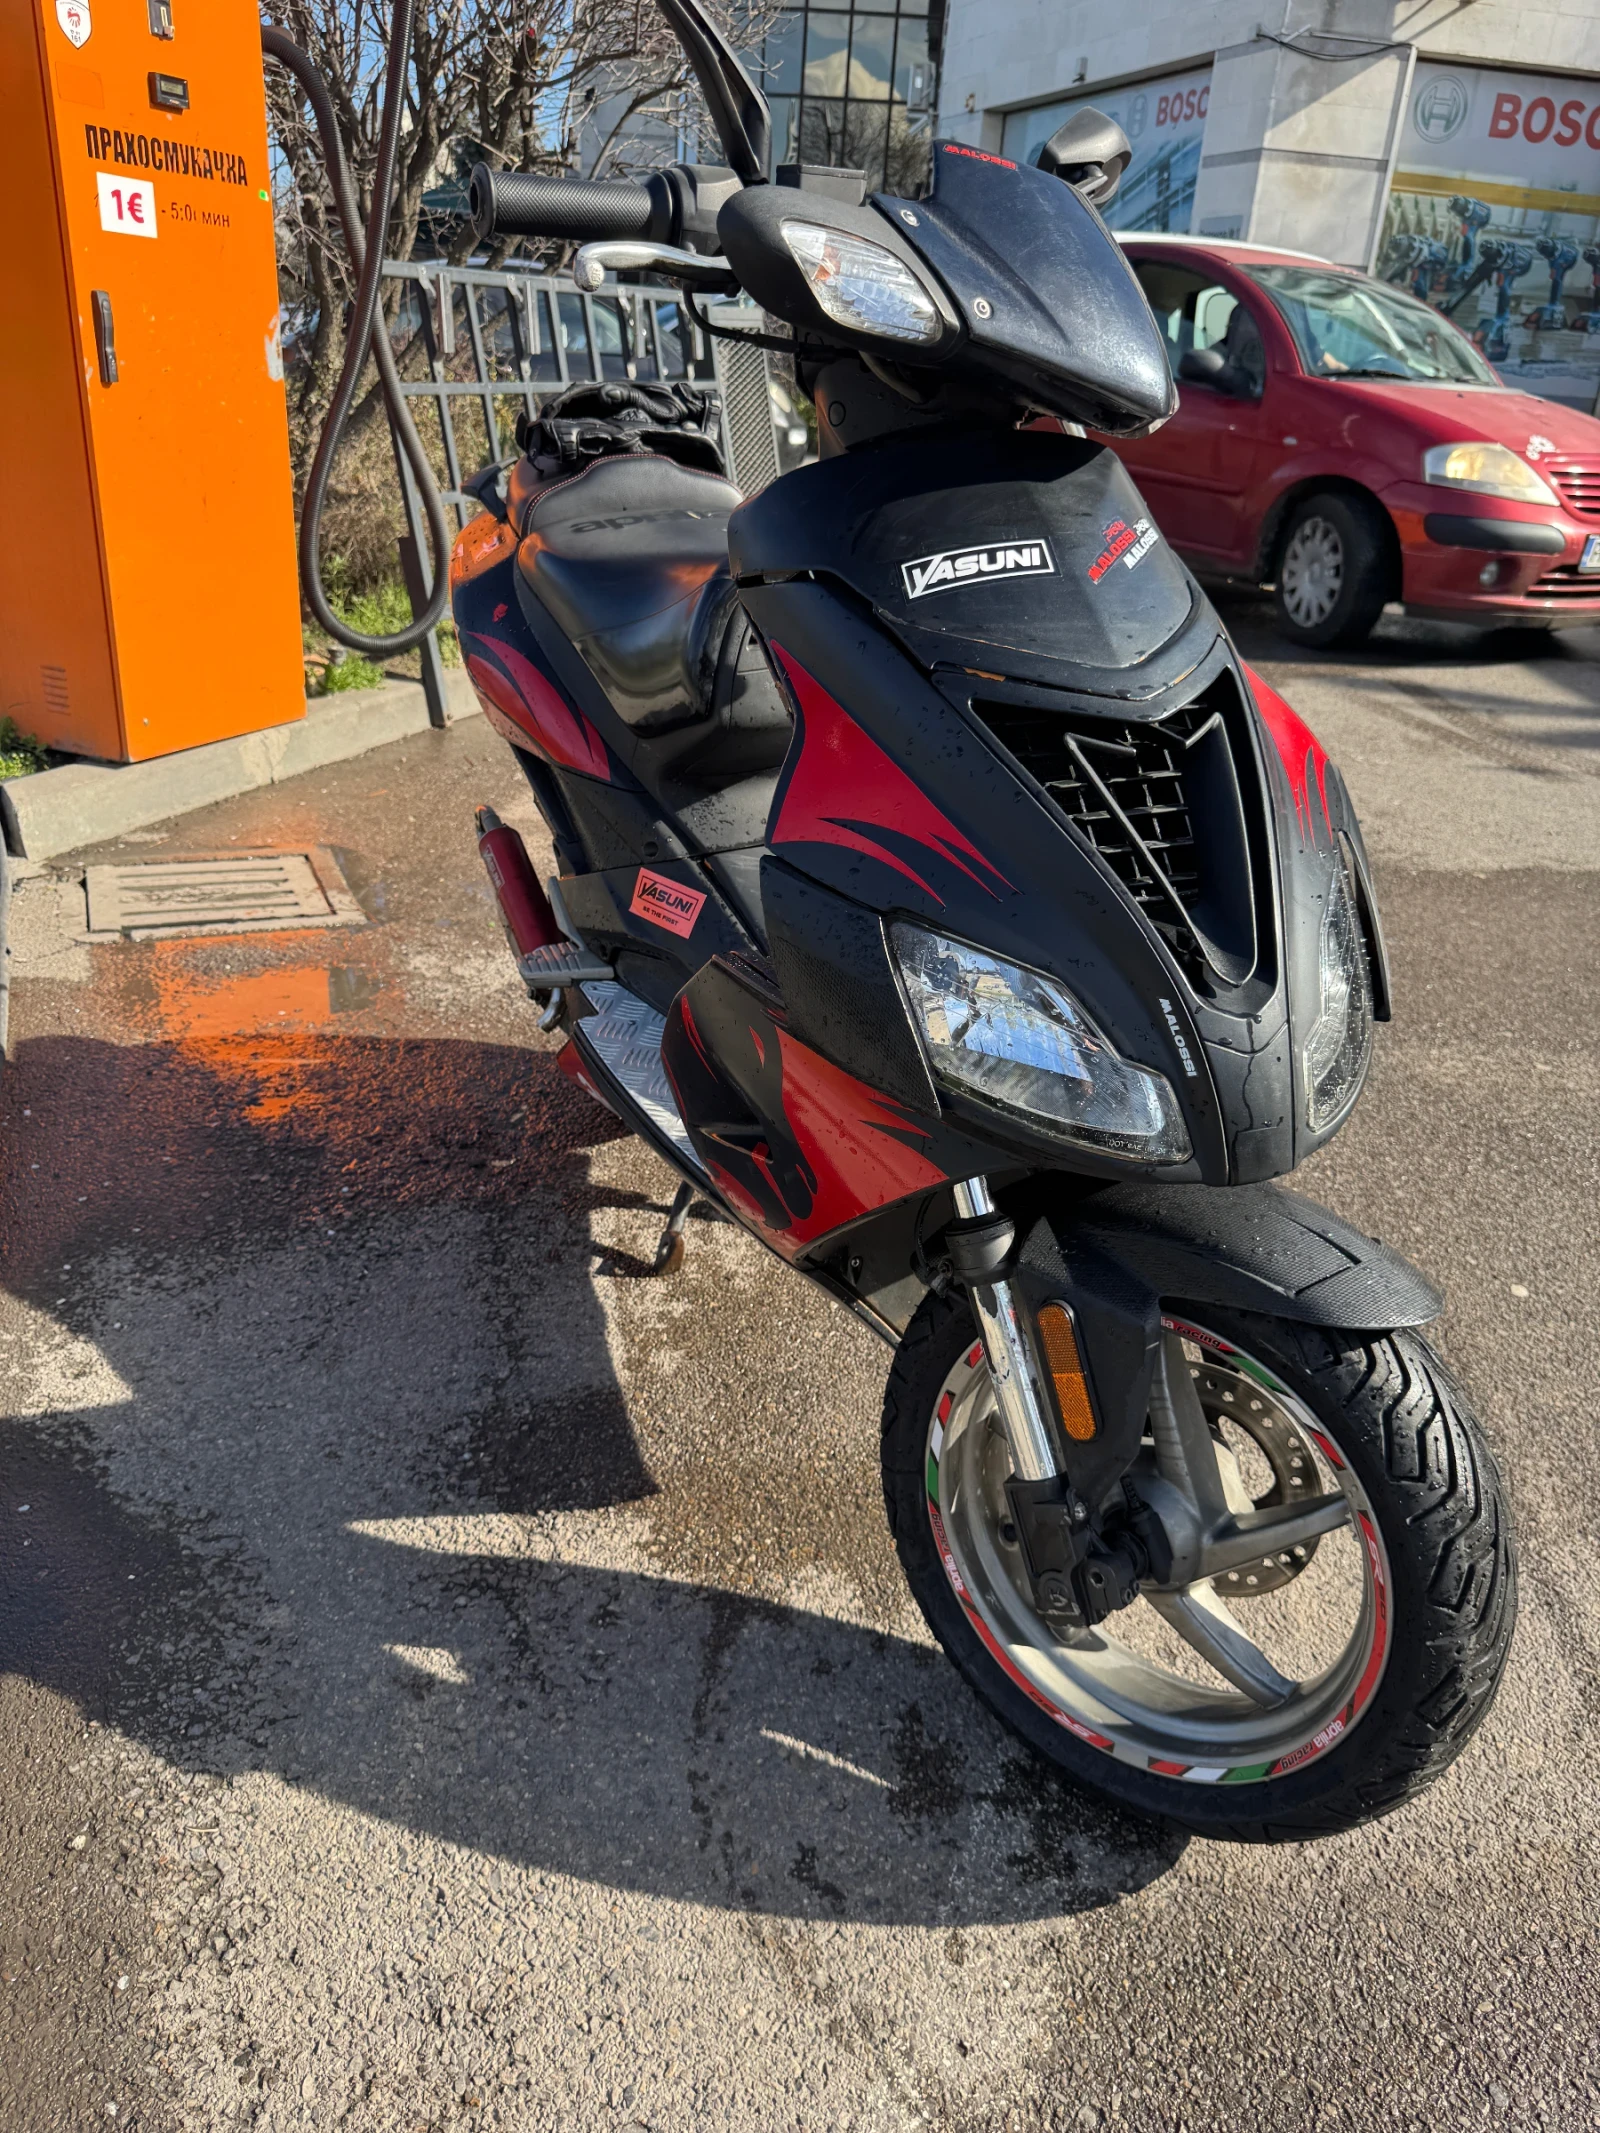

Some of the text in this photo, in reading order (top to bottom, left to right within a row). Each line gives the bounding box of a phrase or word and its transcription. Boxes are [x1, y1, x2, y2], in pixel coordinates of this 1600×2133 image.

[85, 124, 248, 186] ПРАХОСМУКАЧКА
[944, 145, 1018, 171] MALOSSI
[110, 189, 145, 224] 1€
[202, 211, 230, 228] мин
[910, 547, 1041, 597] YASUNI
[1088, 528, 1137, 583] MALOSSI
[638, 881, 693, 914] YASUNI
[642, 906, 679, 926] BE THE FIRST
[1159, 998, 1197, 1077] MALOSSI
[931, 1512, 964, 1592] aprilia racing
[1280, 1719, 1345, 1771] aprilia racing
